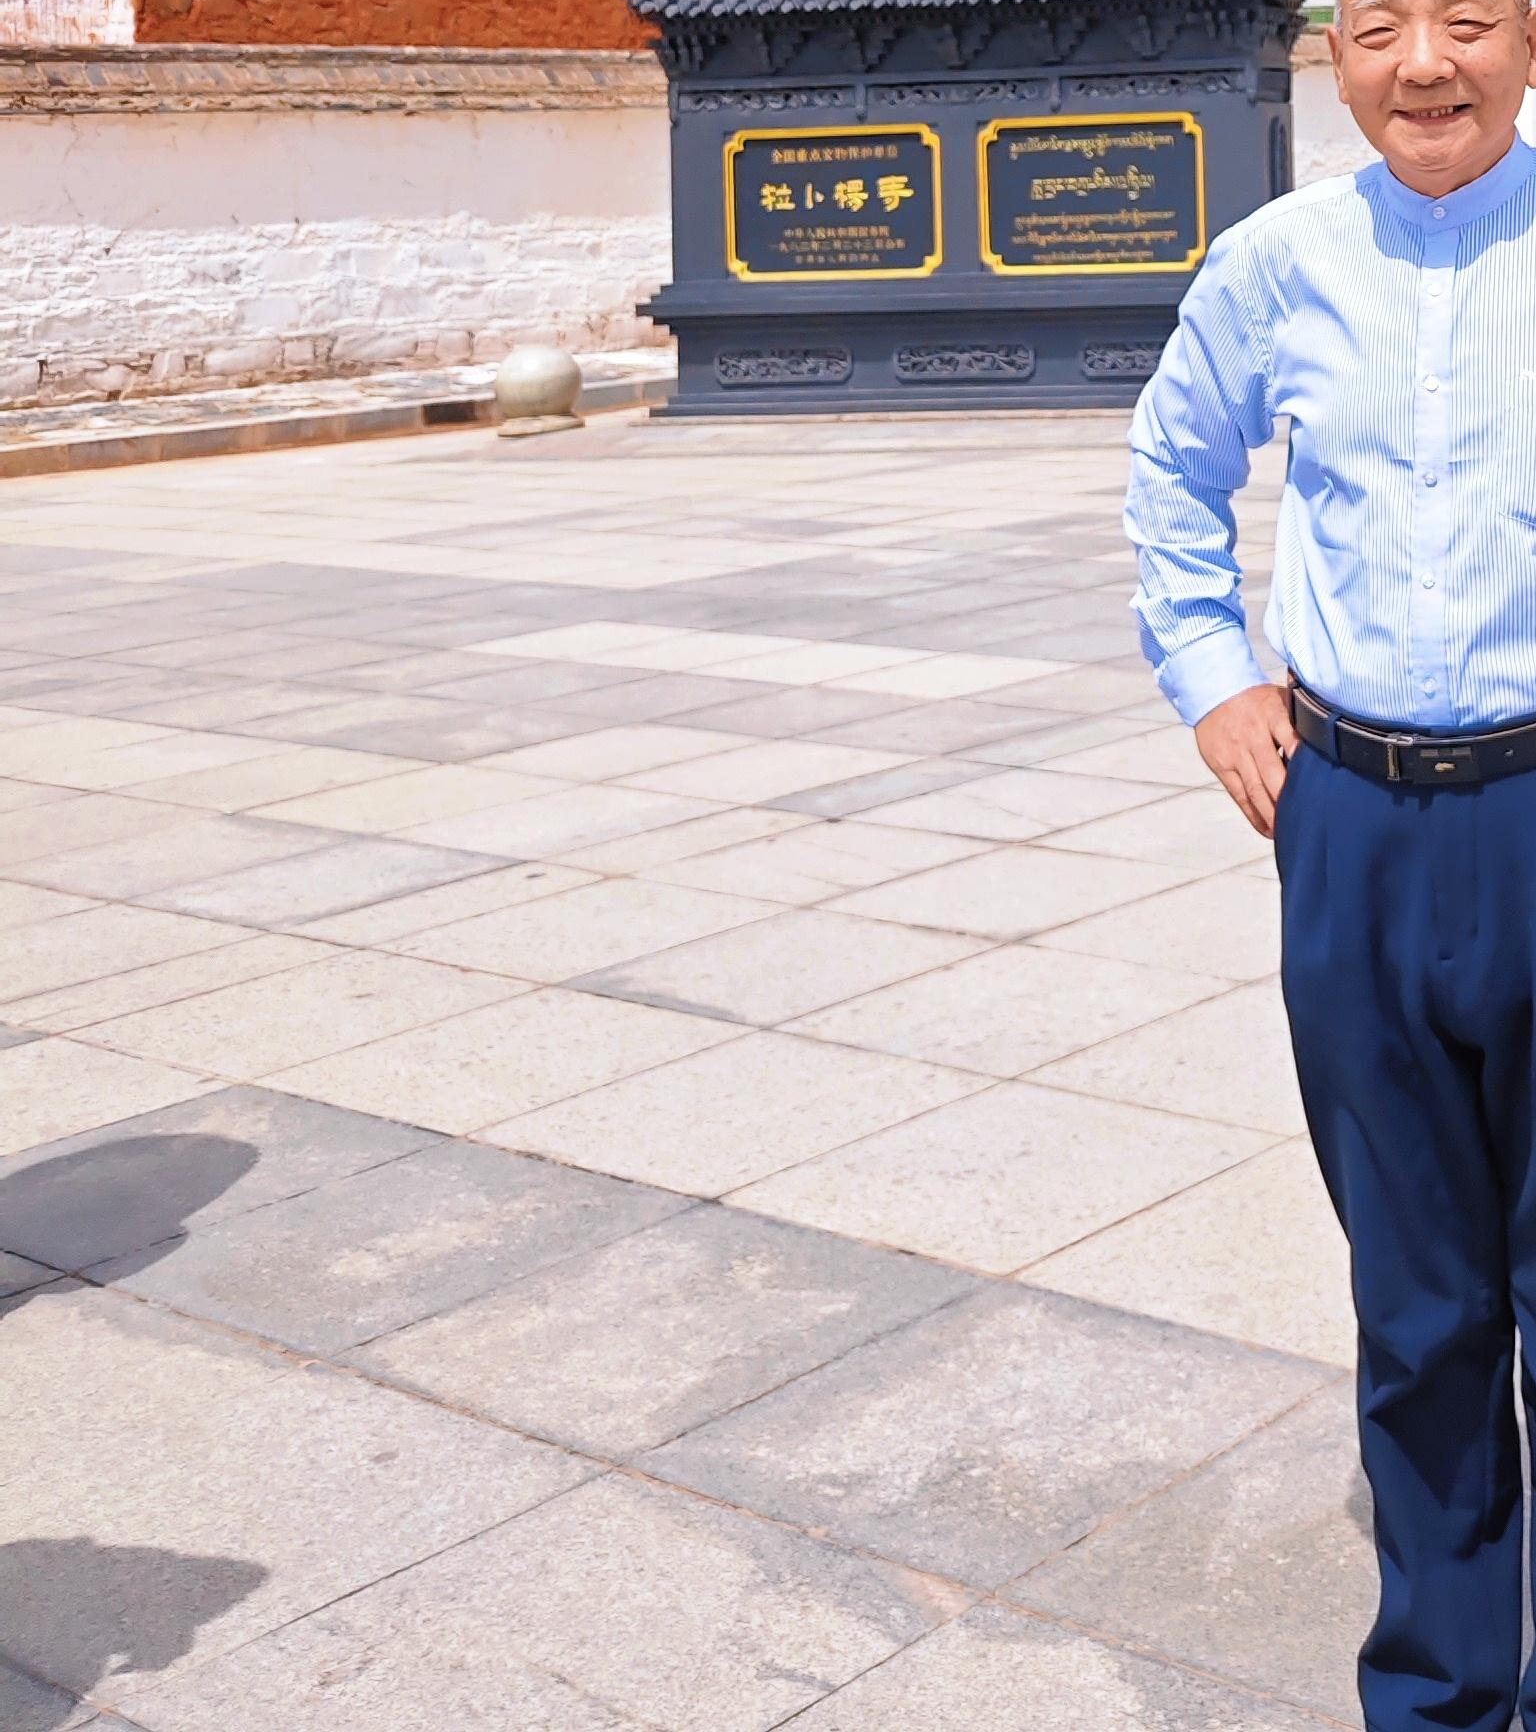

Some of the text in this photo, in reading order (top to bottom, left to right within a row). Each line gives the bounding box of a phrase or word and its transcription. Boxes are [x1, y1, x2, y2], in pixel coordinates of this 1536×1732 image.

[772, 145, 898, 164] 全国重点文物保护单位
[760, 174, 915, 212] 拉卜楞寺
